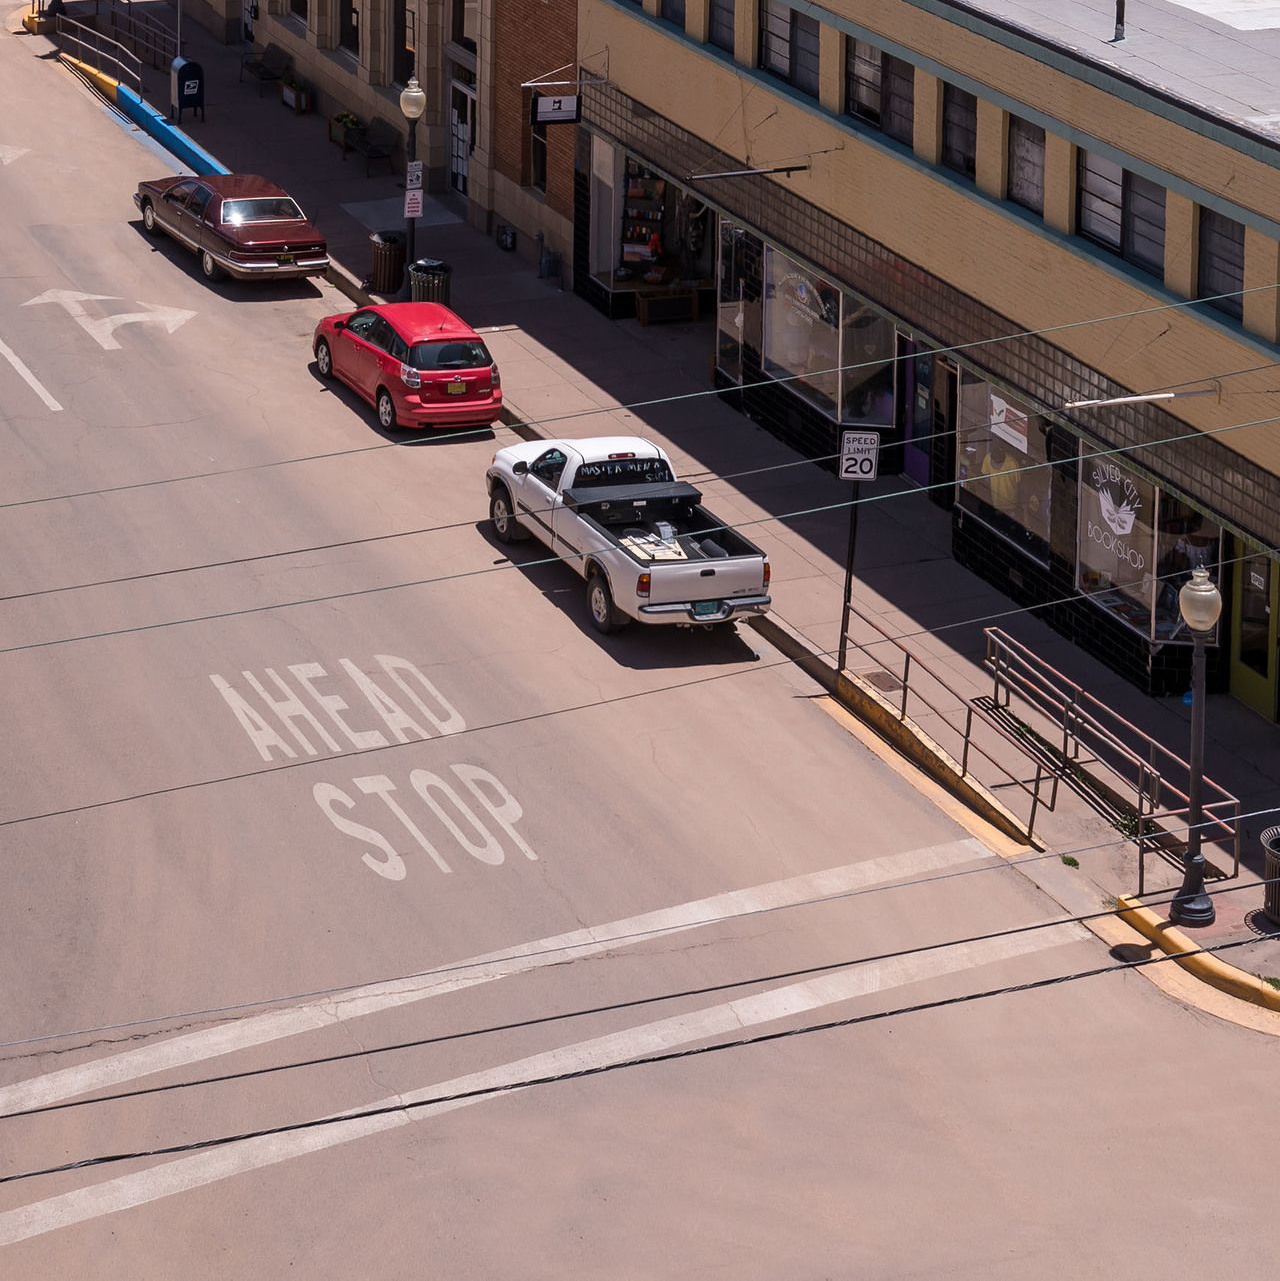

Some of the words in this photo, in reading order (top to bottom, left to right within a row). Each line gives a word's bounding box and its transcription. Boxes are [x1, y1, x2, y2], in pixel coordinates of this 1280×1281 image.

[845, 436, 876, 446] SPEED
[847, 447, 870, 455] LIMIT
[844, 457, 874, 475] 20
[1092, 464, 1121, 488] SILVER
[1123, 478, 1143, 509] CITY
[1087, 520, 1145, 570] BOOKSHOP
[208, 654, 466, 761] AHEAD
[312, 763, 539, 881] STOP
